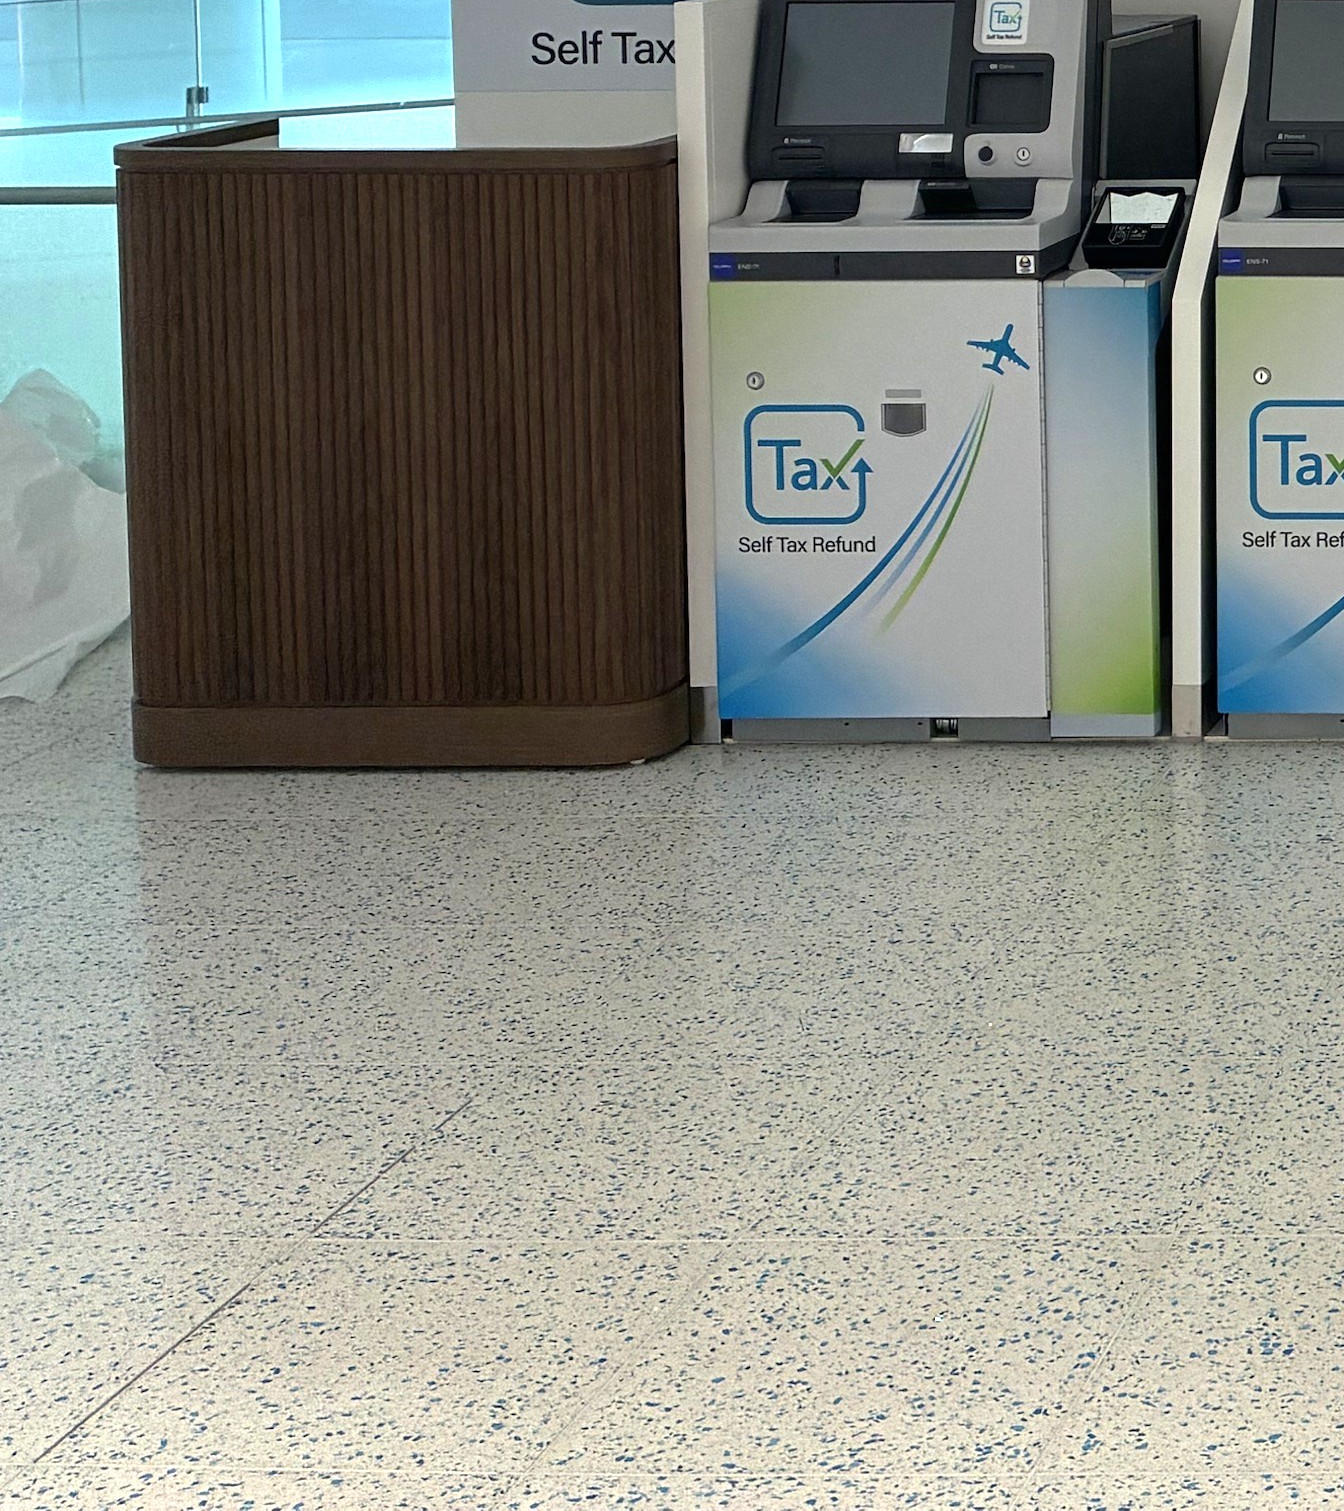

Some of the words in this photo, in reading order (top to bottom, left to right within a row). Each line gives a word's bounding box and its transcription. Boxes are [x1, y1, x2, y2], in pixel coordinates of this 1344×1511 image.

[993, 8, 1021, 25] Tax
[531, 29, 602, 66] Self
[611, 31, 676, 66] Tax
[757, 438, 865, 491] Tax
[738, 536, 774, 553] Self
[776, 536, 807, 553] Tax
[813, 536, 876, 553] Refund
[1242, 531, 1277, 548] Self
[1280, 531, 1311, 548] Tax
